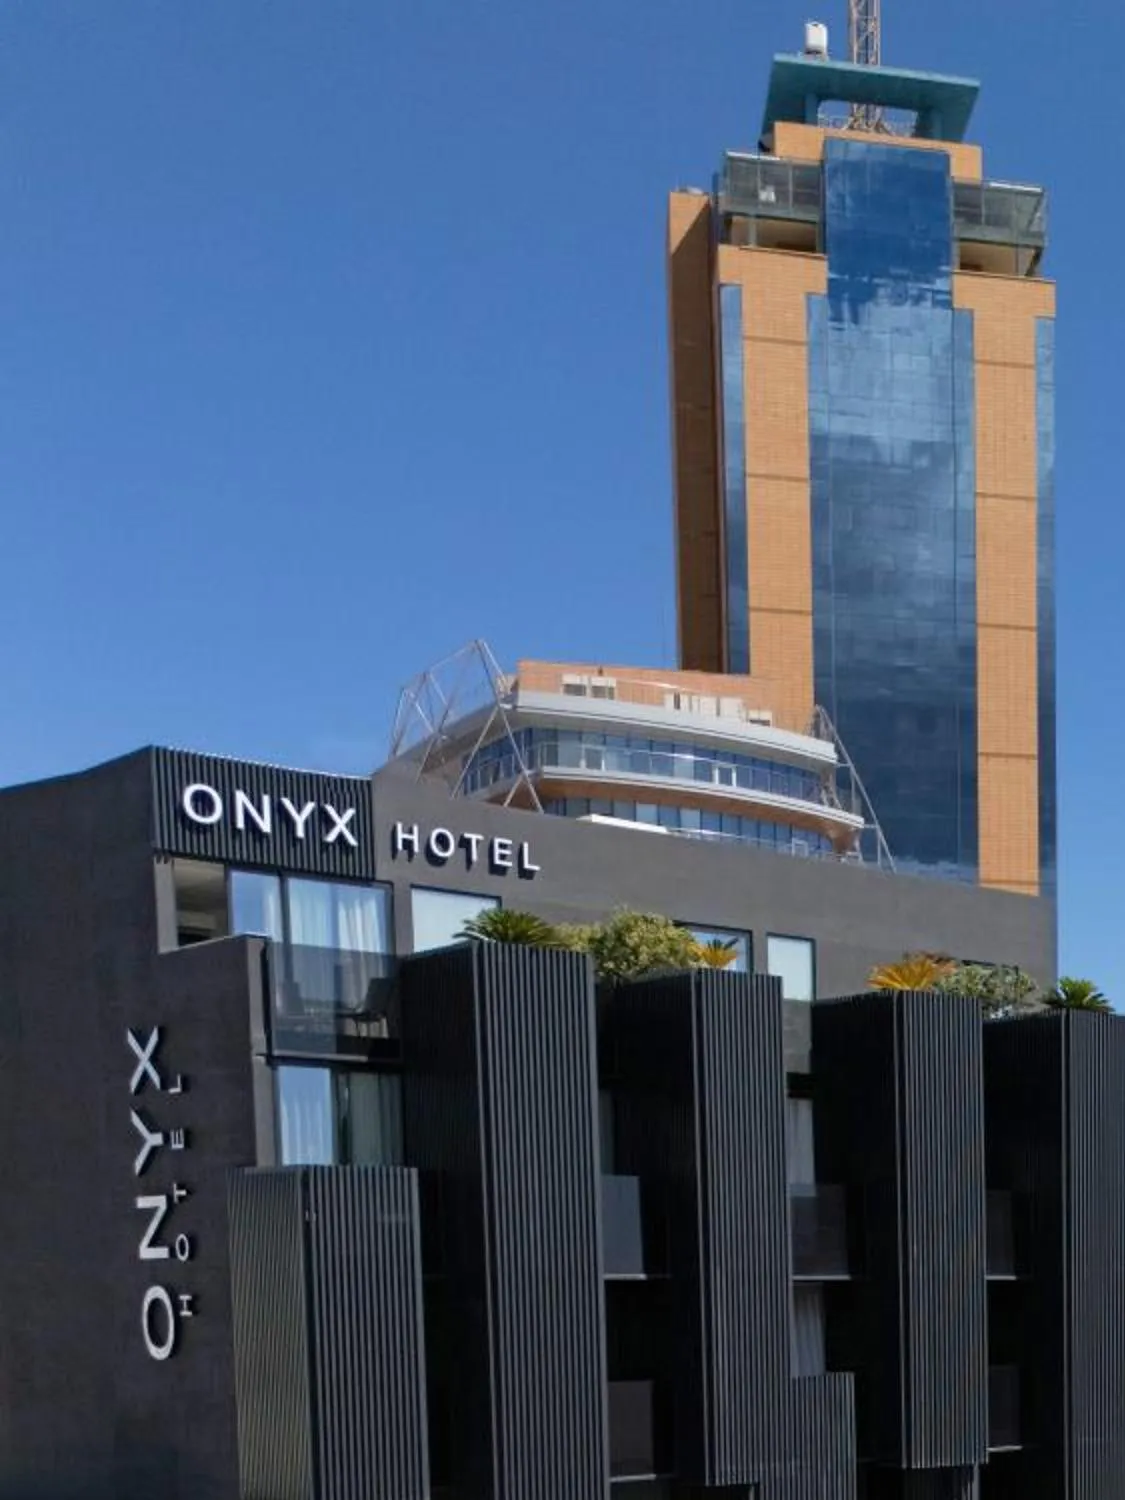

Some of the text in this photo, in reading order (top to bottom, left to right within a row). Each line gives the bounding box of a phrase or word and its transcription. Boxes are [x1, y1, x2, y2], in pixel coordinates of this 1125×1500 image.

[183, 783, 540, 871] ONYX HOTEL
[127, 1025, 175, 1361] ONYX
[168, 1073, 193, 1317] HOTEL
